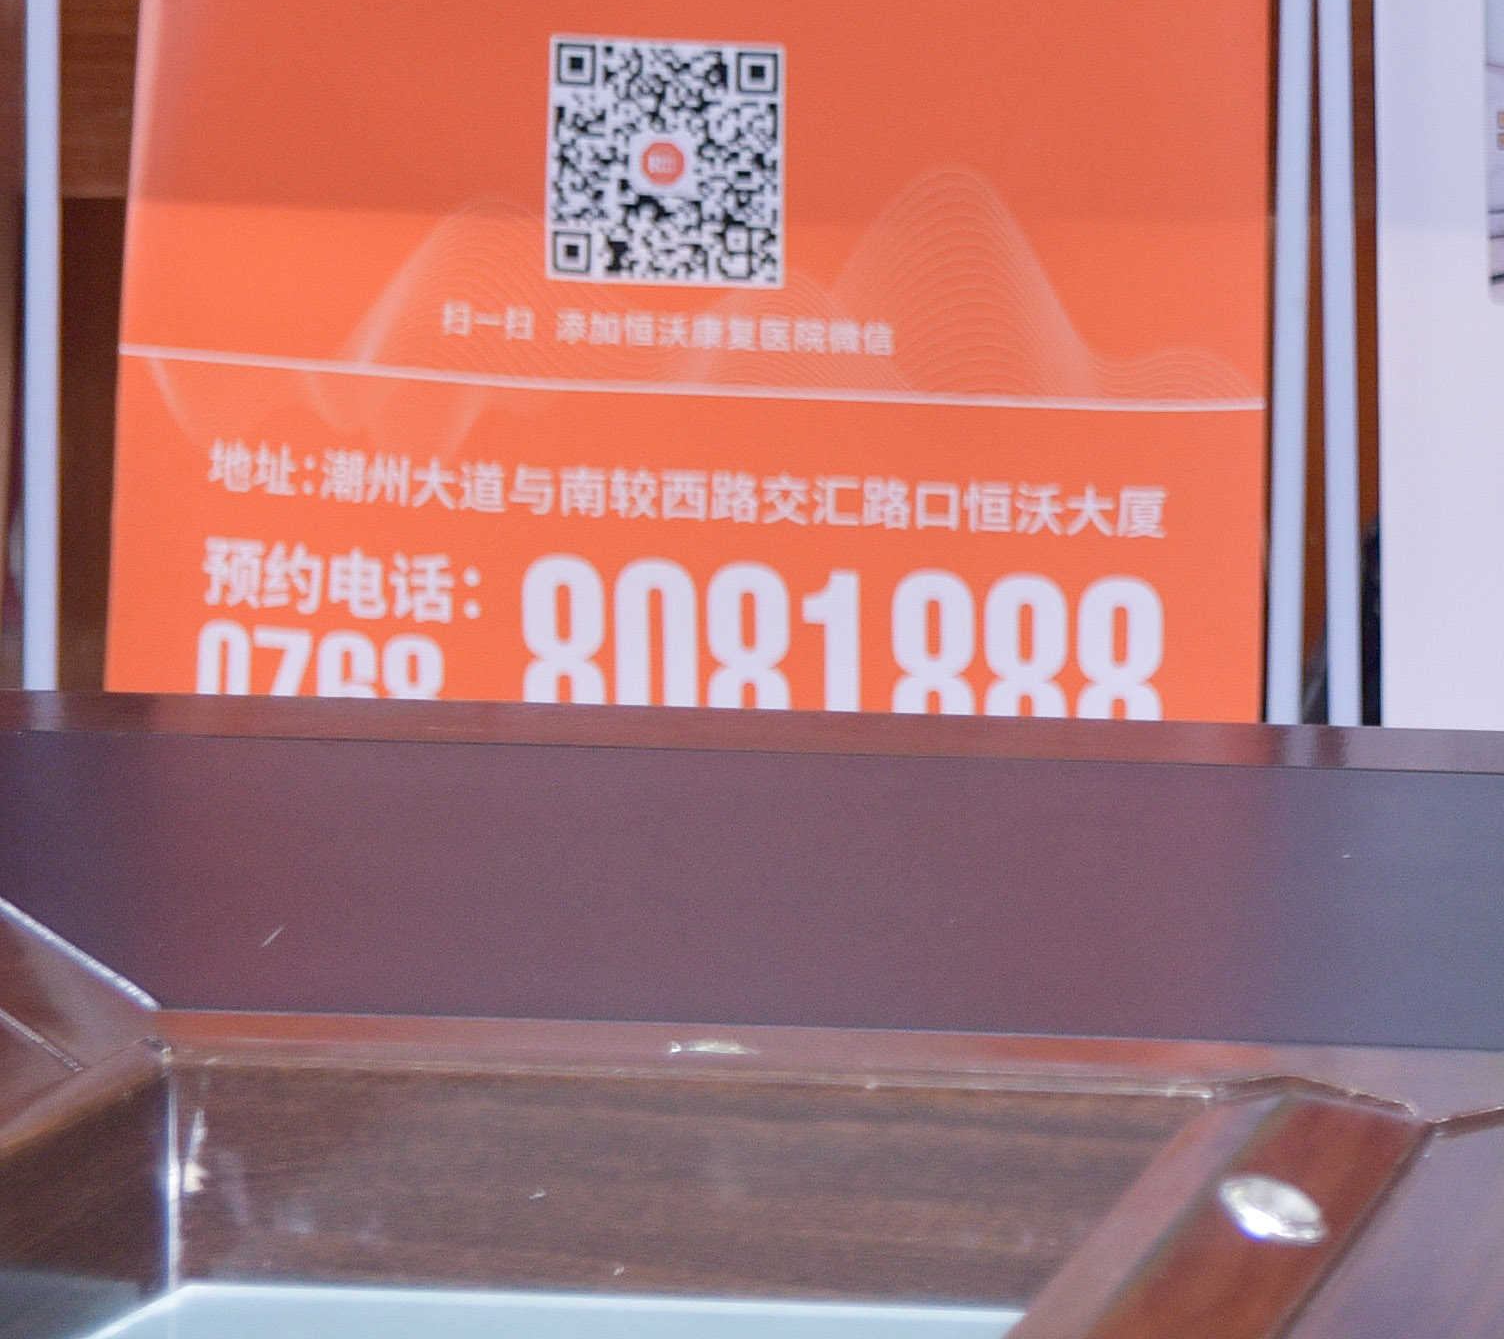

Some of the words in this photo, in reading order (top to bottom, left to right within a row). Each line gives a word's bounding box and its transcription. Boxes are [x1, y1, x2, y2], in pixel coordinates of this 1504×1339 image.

[441, 302, 534, 342] 扫一扫
[555, 308, 894, 359] 添加恒沃康复医院微信
[201, 536, 484, 625] 预约电话：
